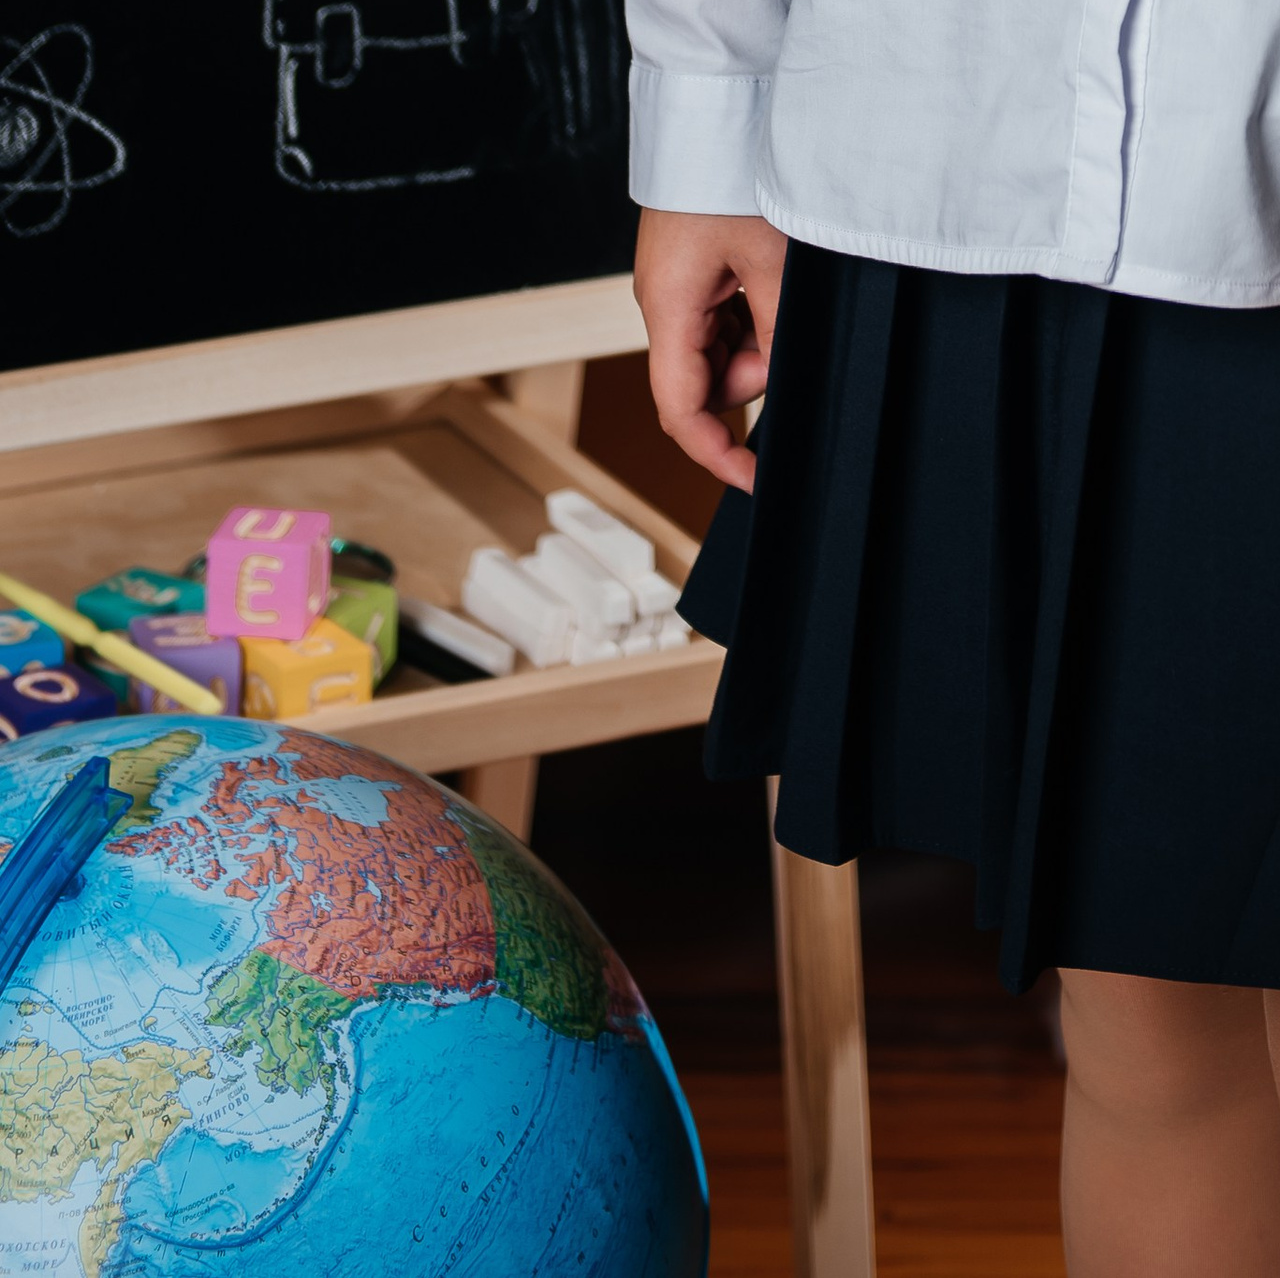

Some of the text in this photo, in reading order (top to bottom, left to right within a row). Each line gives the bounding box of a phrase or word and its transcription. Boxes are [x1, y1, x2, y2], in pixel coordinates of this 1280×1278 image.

[235, 553, 284, 625] E
[112, 864, 134, 910] ОКЕАН
[209, 917, 229, 943] МОРЕ
[65, 994, 116, 1014] ВОСТОЧНО-
[81, 1014, 107, 1028] МОРЕ
[224, 1141, 255, 1165] МОРЕ
[21, 1259, 58, 1272] МОРЕ
